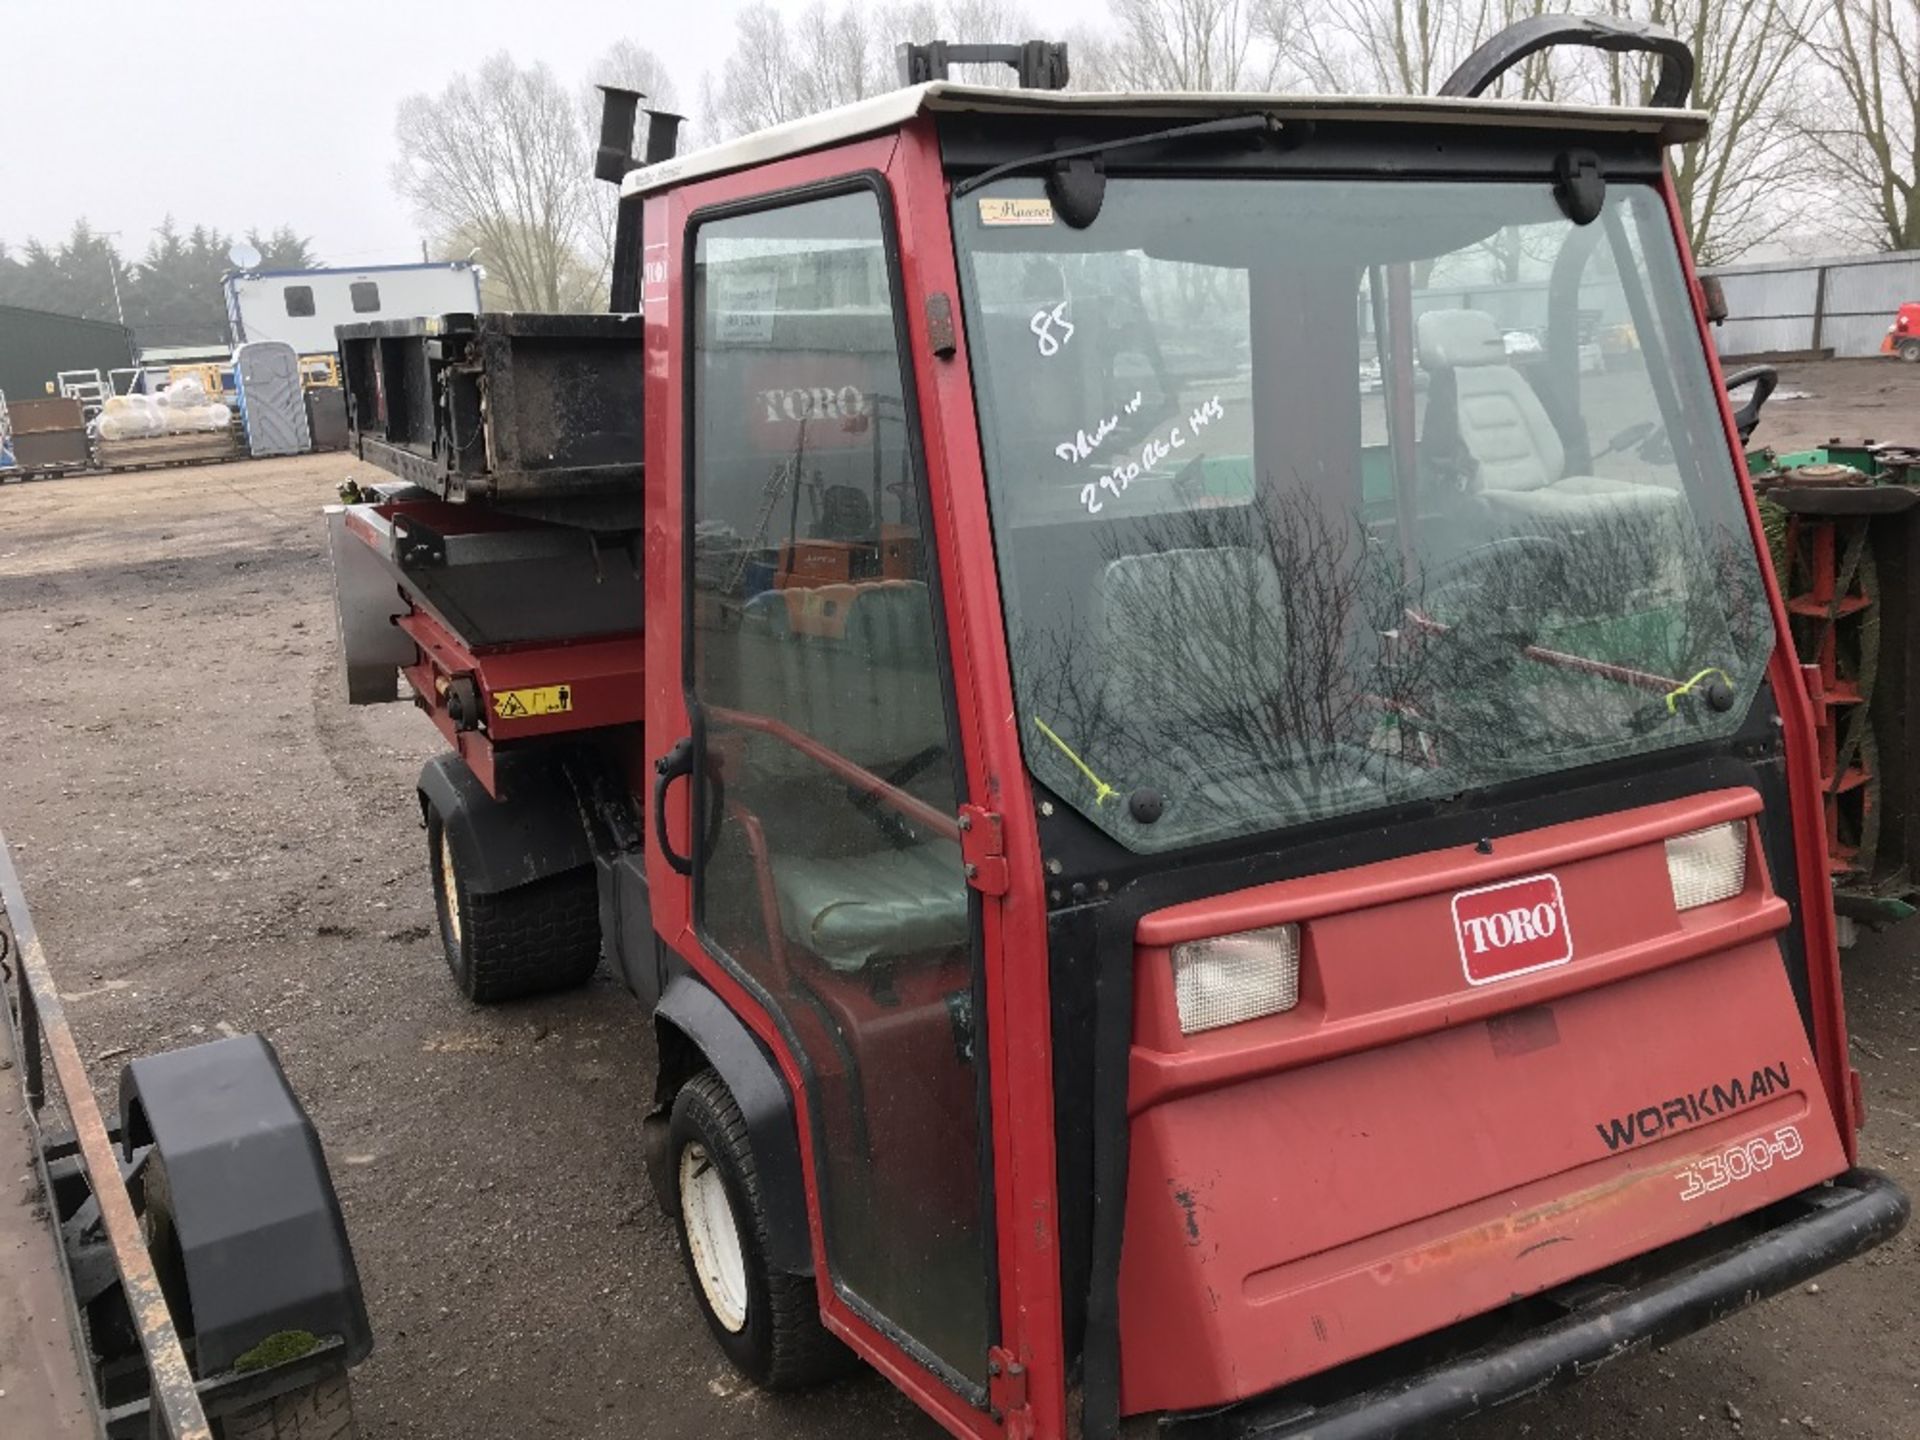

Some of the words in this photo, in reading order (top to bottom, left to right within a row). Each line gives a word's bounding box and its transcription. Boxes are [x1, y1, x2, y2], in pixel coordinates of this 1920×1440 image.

[1030, 301, 1074, 356] 85
[1080, 462, 1140, 514] 2930
[1463, 903, 1557, 953] TORO
[1595, 1062, 1791, 1150] WORKMAN
[1674, 1126, 1803, 1201] 3300-D
